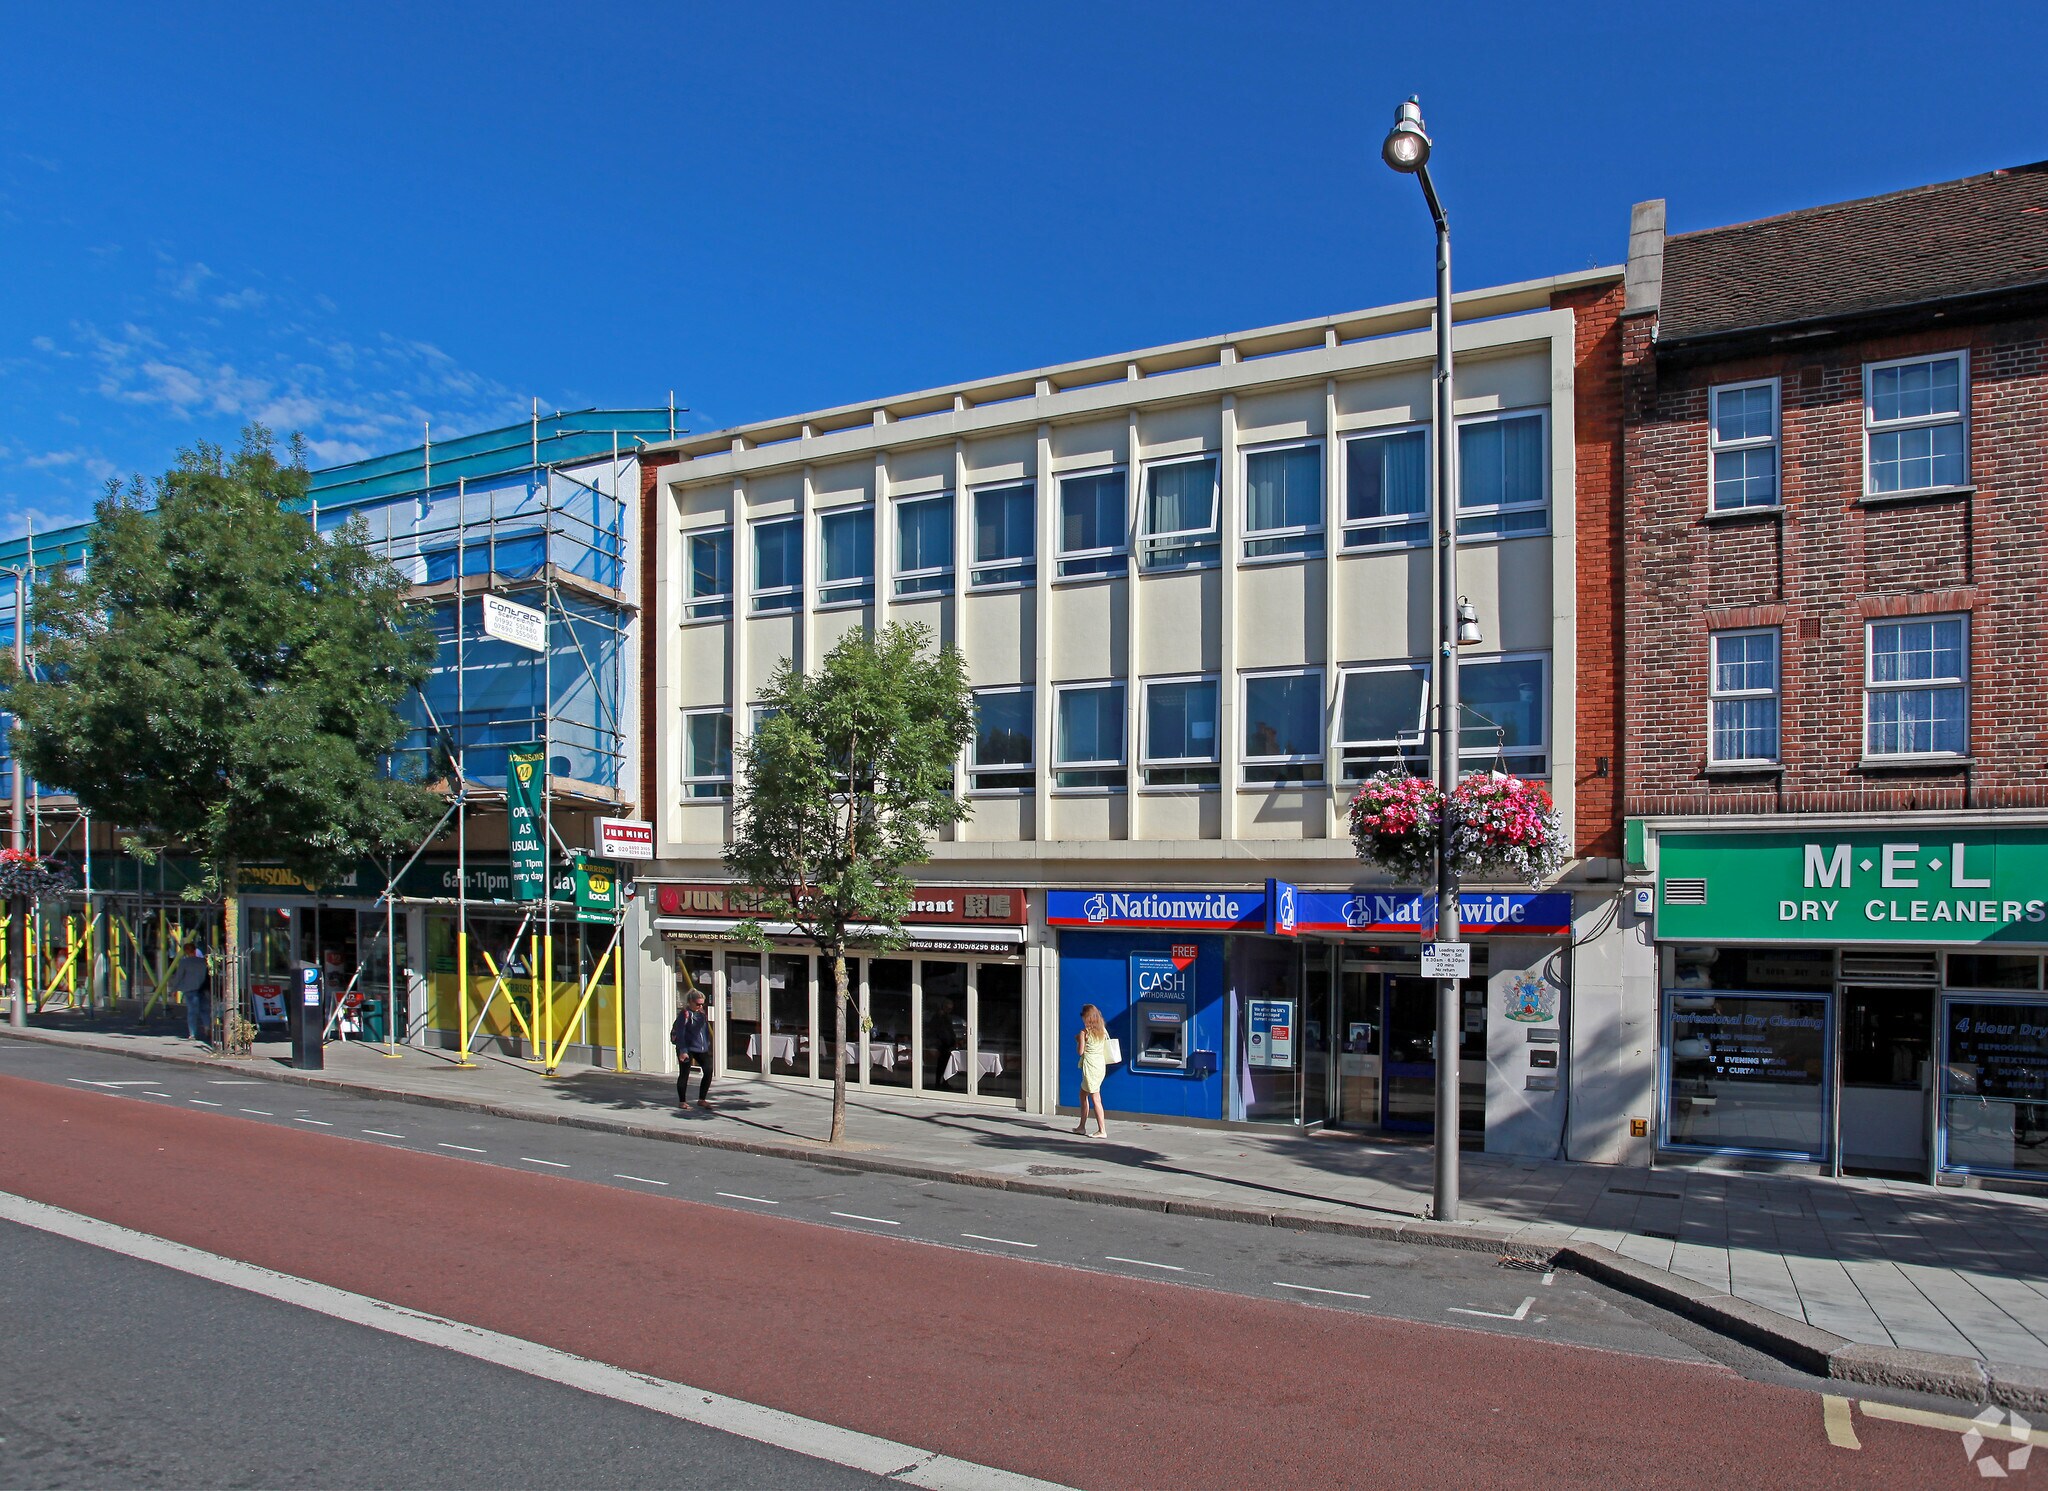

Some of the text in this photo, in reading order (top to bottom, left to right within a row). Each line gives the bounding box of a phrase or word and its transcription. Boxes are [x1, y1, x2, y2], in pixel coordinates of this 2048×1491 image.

[489, 600, 542, 624] Contract
[513, 807, 534, 818] OPEN
[520, 823, 532, 835] AS
[606, 828, 650, 839] JUN MING
[512, 840, 540, 852] USUAL
[525, 859, 543, 870] 11pm
[578, 864, 615, 874] MORRISON
[514, 871, 544, 882] every day
[588, 891, 610, 902] local
[680, 890, 723, 912] JUN
[1110, 893, 1239, 920] Nationwide
[1374, 896, 1526, 923] Natwide
[1779, 899, 2046, 922] DRY CLEANERS
[1172, 946, 1196, 957] FREE
[1139, 972, 1185, 991] CASH
[1140, 992, 1185, 1000] WITHDRAWALS
[1670, 1012, 1824, 1030] Professional Dry Cleaning
[1956, 1018, 2048, 1038] 4 Hour Dry
[1762, 1057, 1787, 1066] WEAR
[1729, 1066, 1808, 1077] CURTAIN CLEANING
